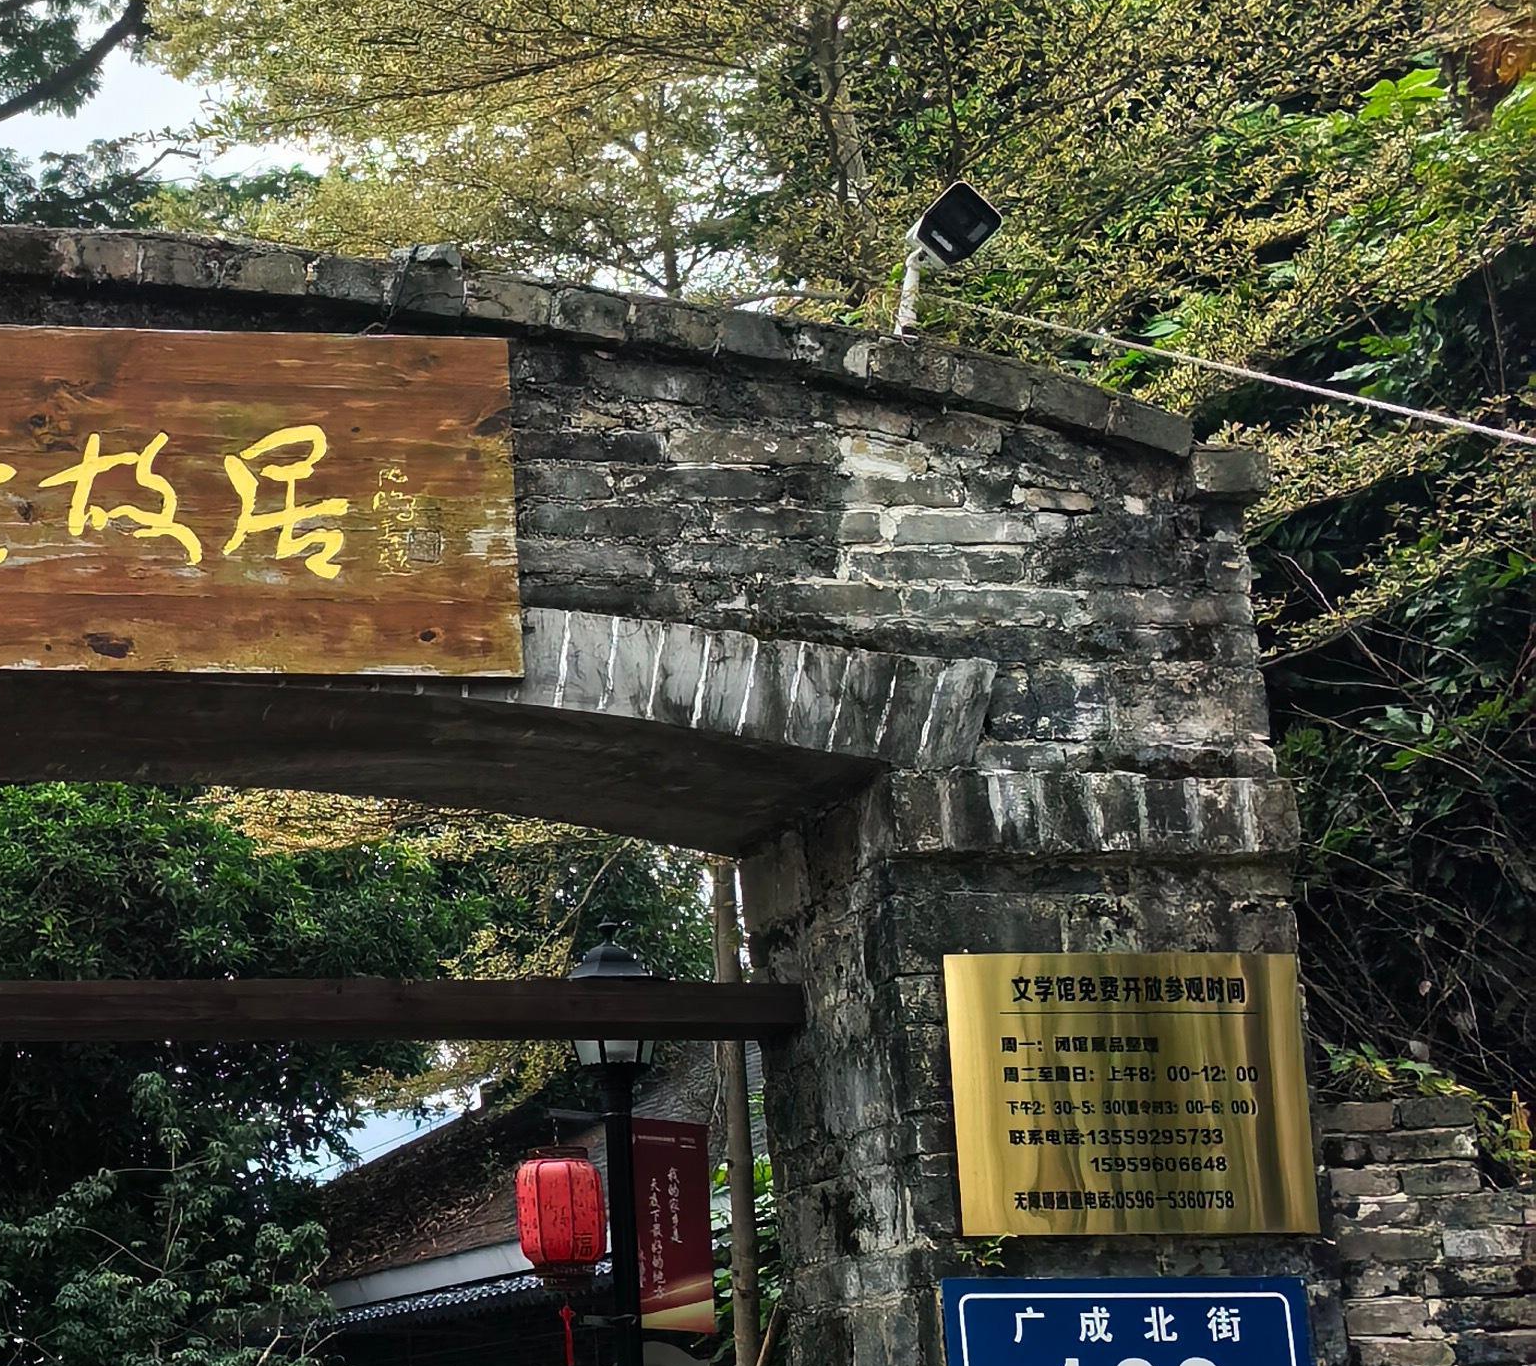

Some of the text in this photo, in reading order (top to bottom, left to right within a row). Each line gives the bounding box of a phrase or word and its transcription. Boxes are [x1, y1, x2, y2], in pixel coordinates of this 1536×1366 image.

[1012, 977, 1246, 1003] 文学馆免费开放参观时间
[1089, 1156, 1228, 1172] 15959606648
[1014, 1306, 1241, 1343] 广成北街
